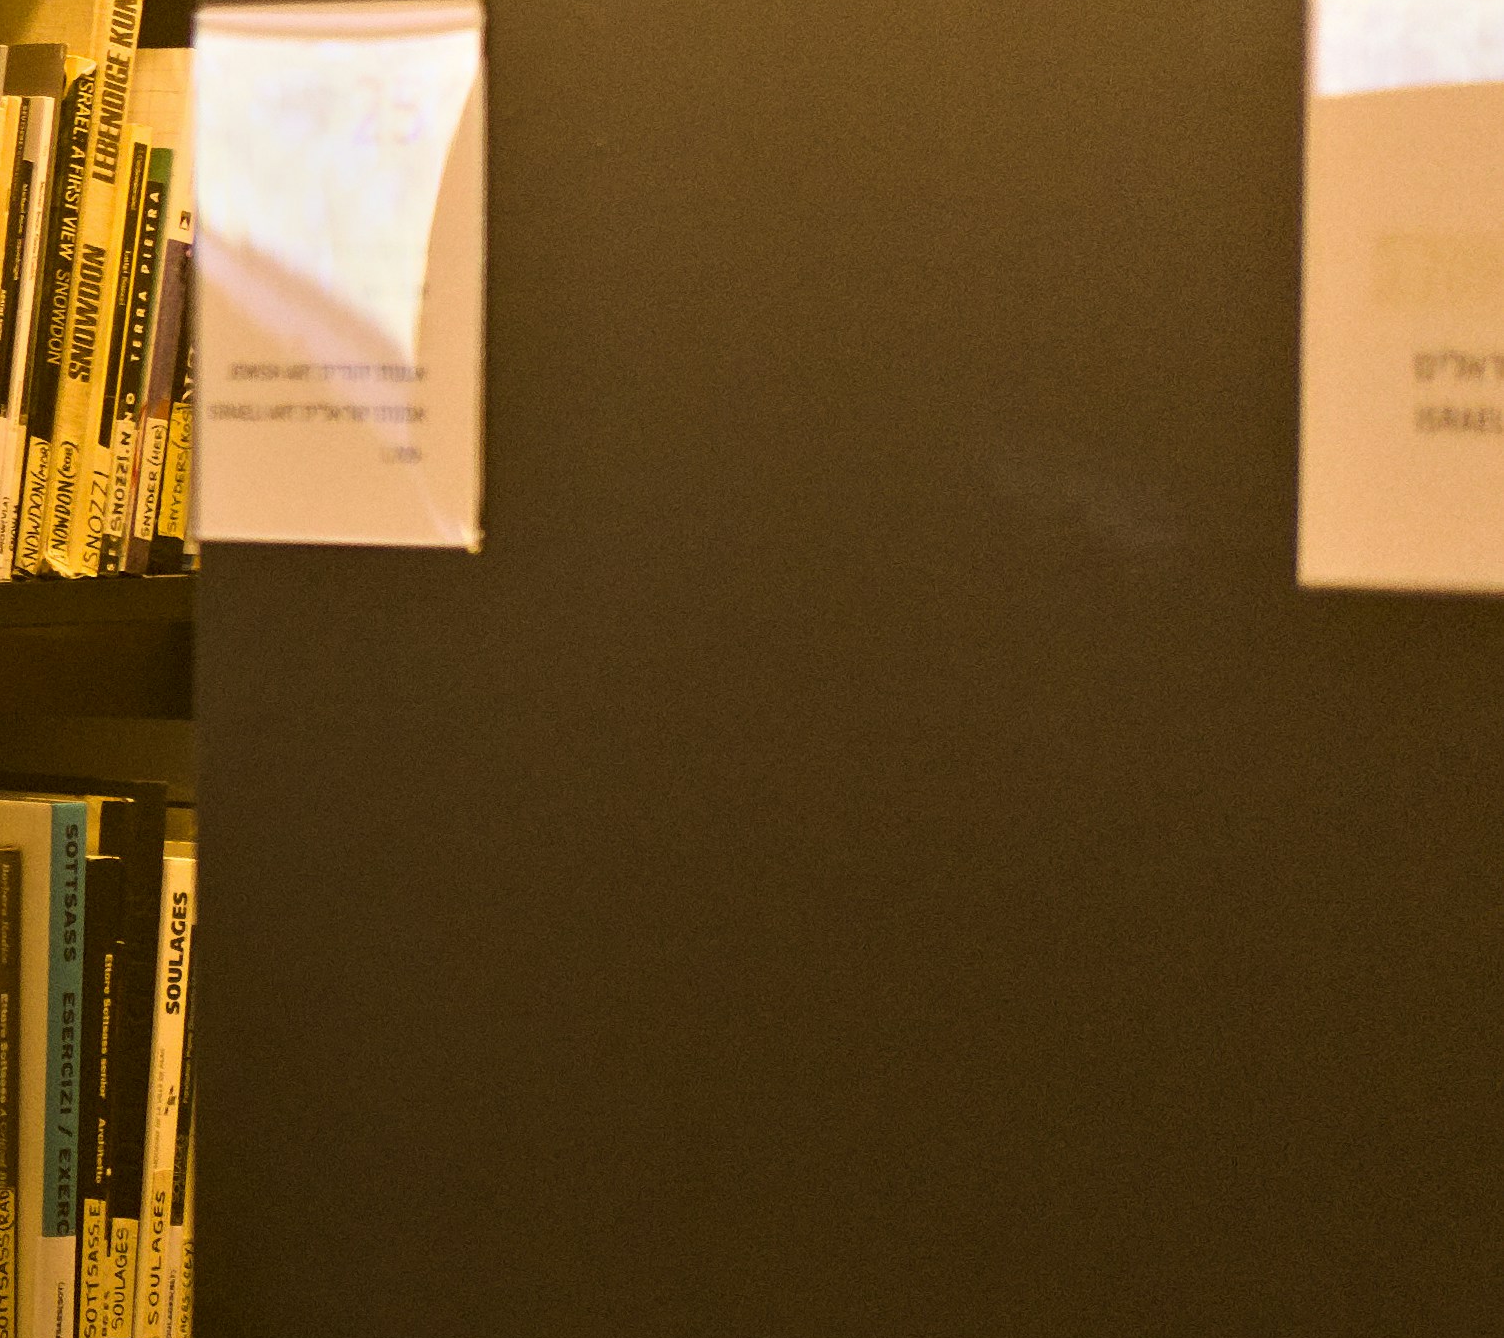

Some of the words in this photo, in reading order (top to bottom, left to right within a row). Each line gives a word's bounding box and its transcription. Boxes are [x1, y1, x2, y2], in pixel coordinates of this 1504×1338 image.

[63, 166, 86, 212] FIRST
[68, 243, 106, 383] SNOWDON
[91, 49, 132, 185] LEBENDIGE
[58, 213, 79, 262] VIEW
[46, 269, 72, 364] SNOWDON
[129, 291, 149, 362] TERRA
[82, 470, 109, 563] SNOZZI
[140, 470, 158, 537] SNYDER
[63, 824, 79, 962] SOTTSASS
[164, 891, 188, 1015] SOULAGES
[57, 992, 76, 1115] ESERCIZI
[55, 1149, 72, 1235] EXERC
[111, 1227, 129, 1331] SOULAGES
[146, 1190, 166, 1325] SOULAGES
